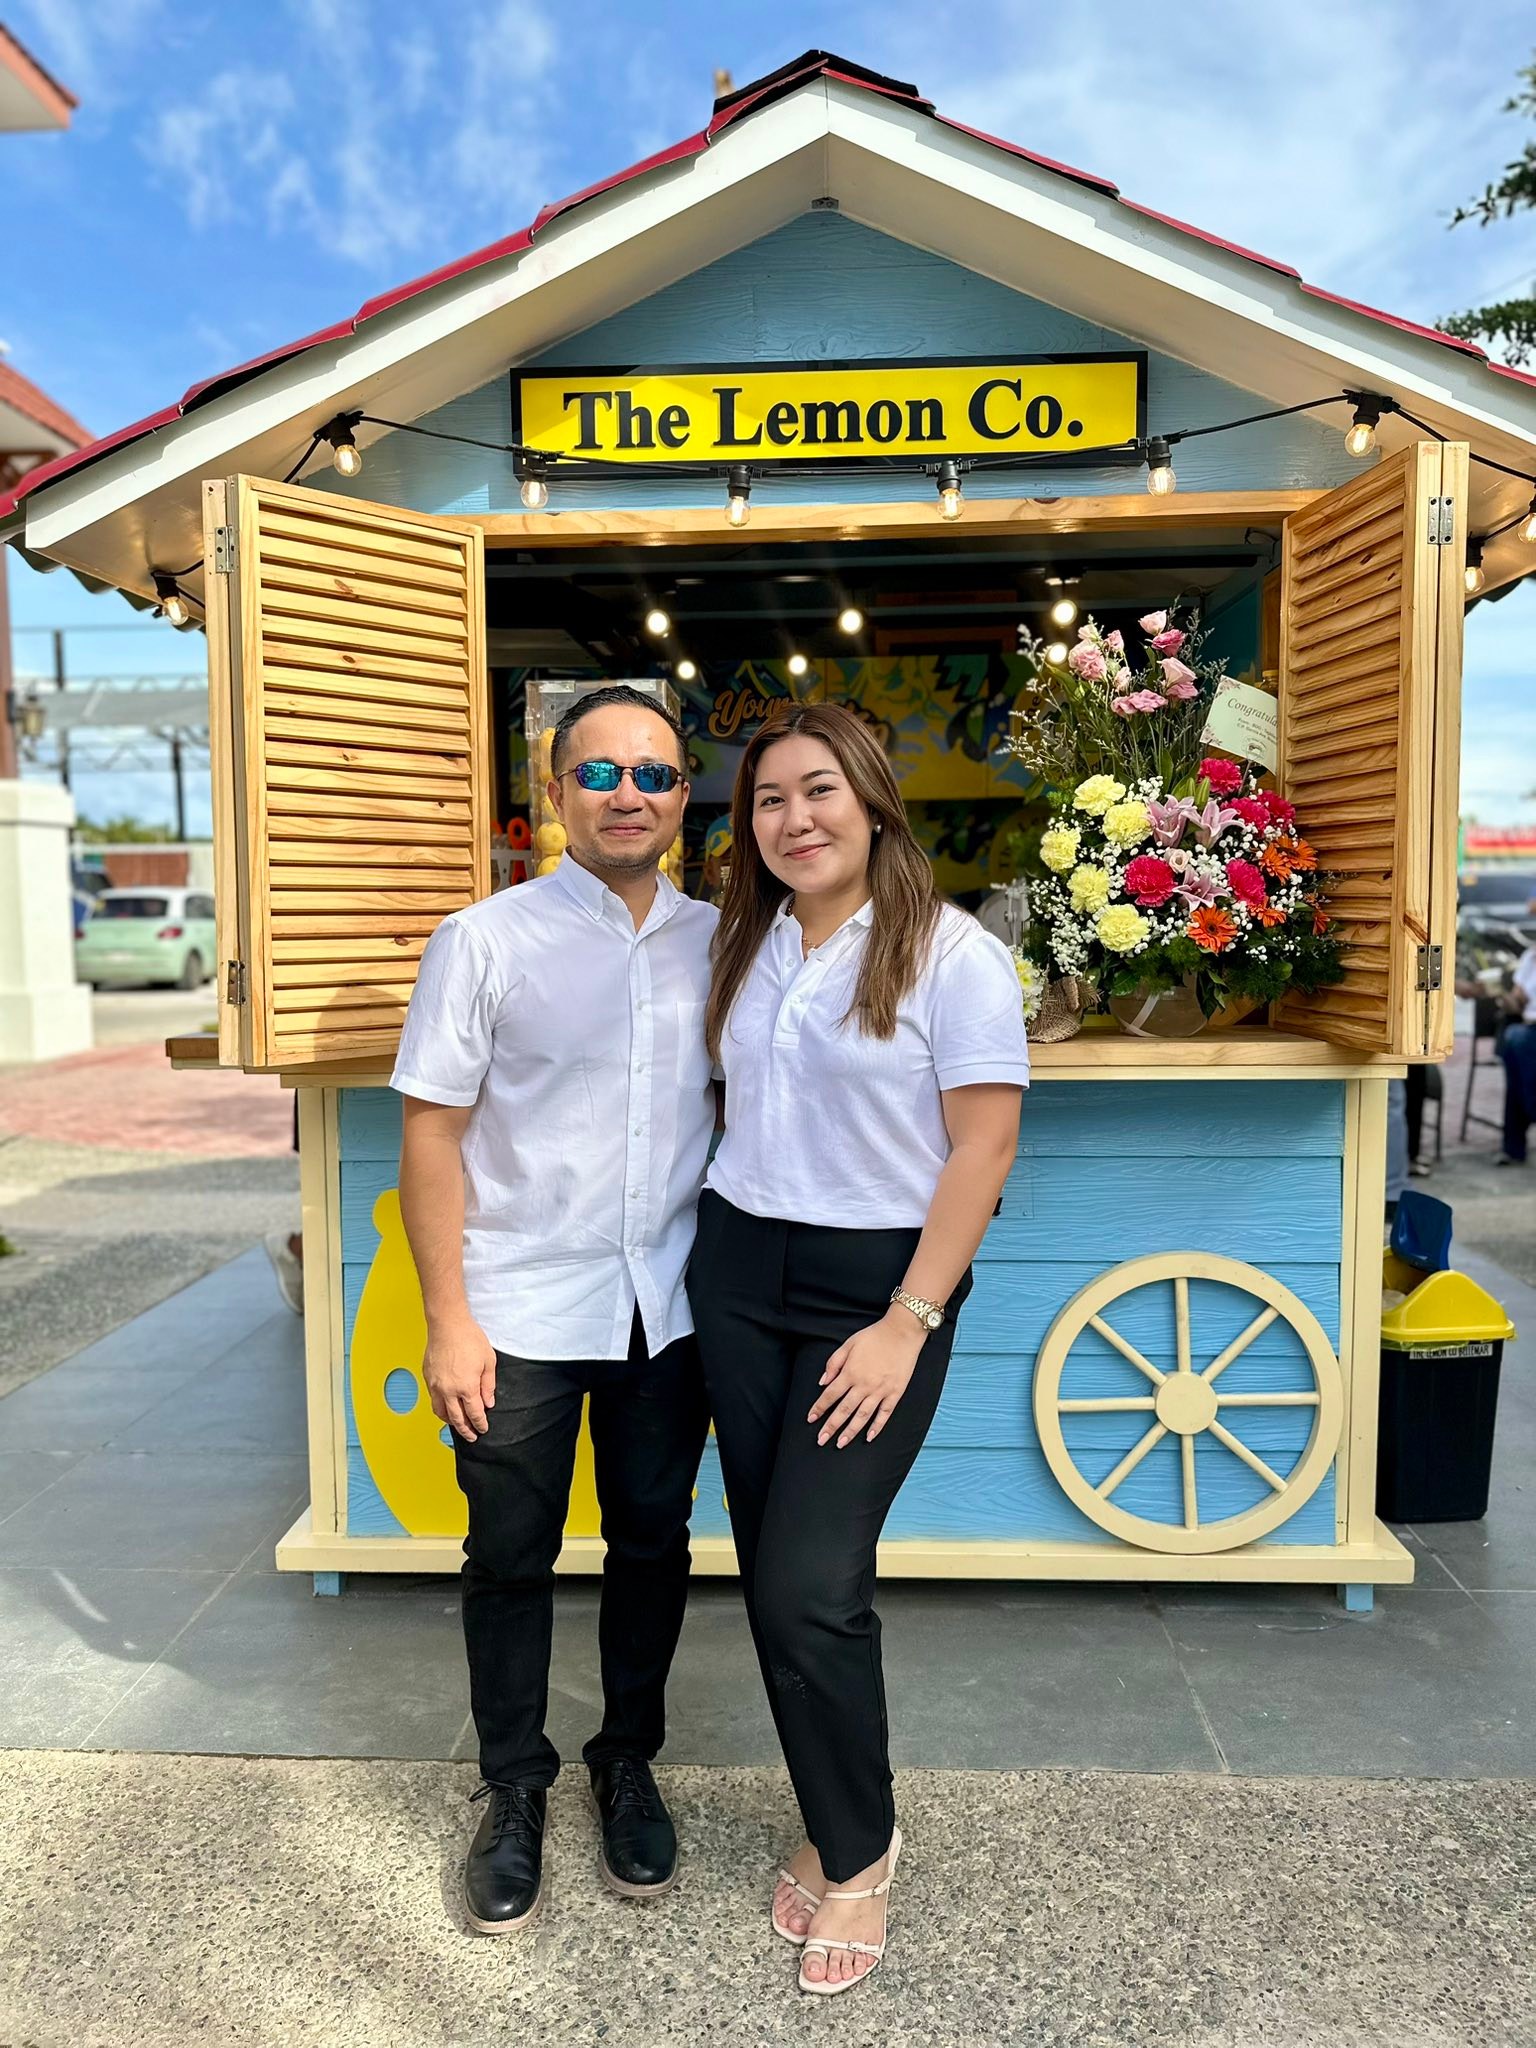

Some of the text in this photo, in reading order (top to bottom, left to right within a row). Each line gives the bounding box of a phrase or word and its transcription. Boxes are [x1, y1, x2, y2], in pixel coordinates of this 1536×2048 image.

[562, 378, 1084, 450] The Lemon Co.
